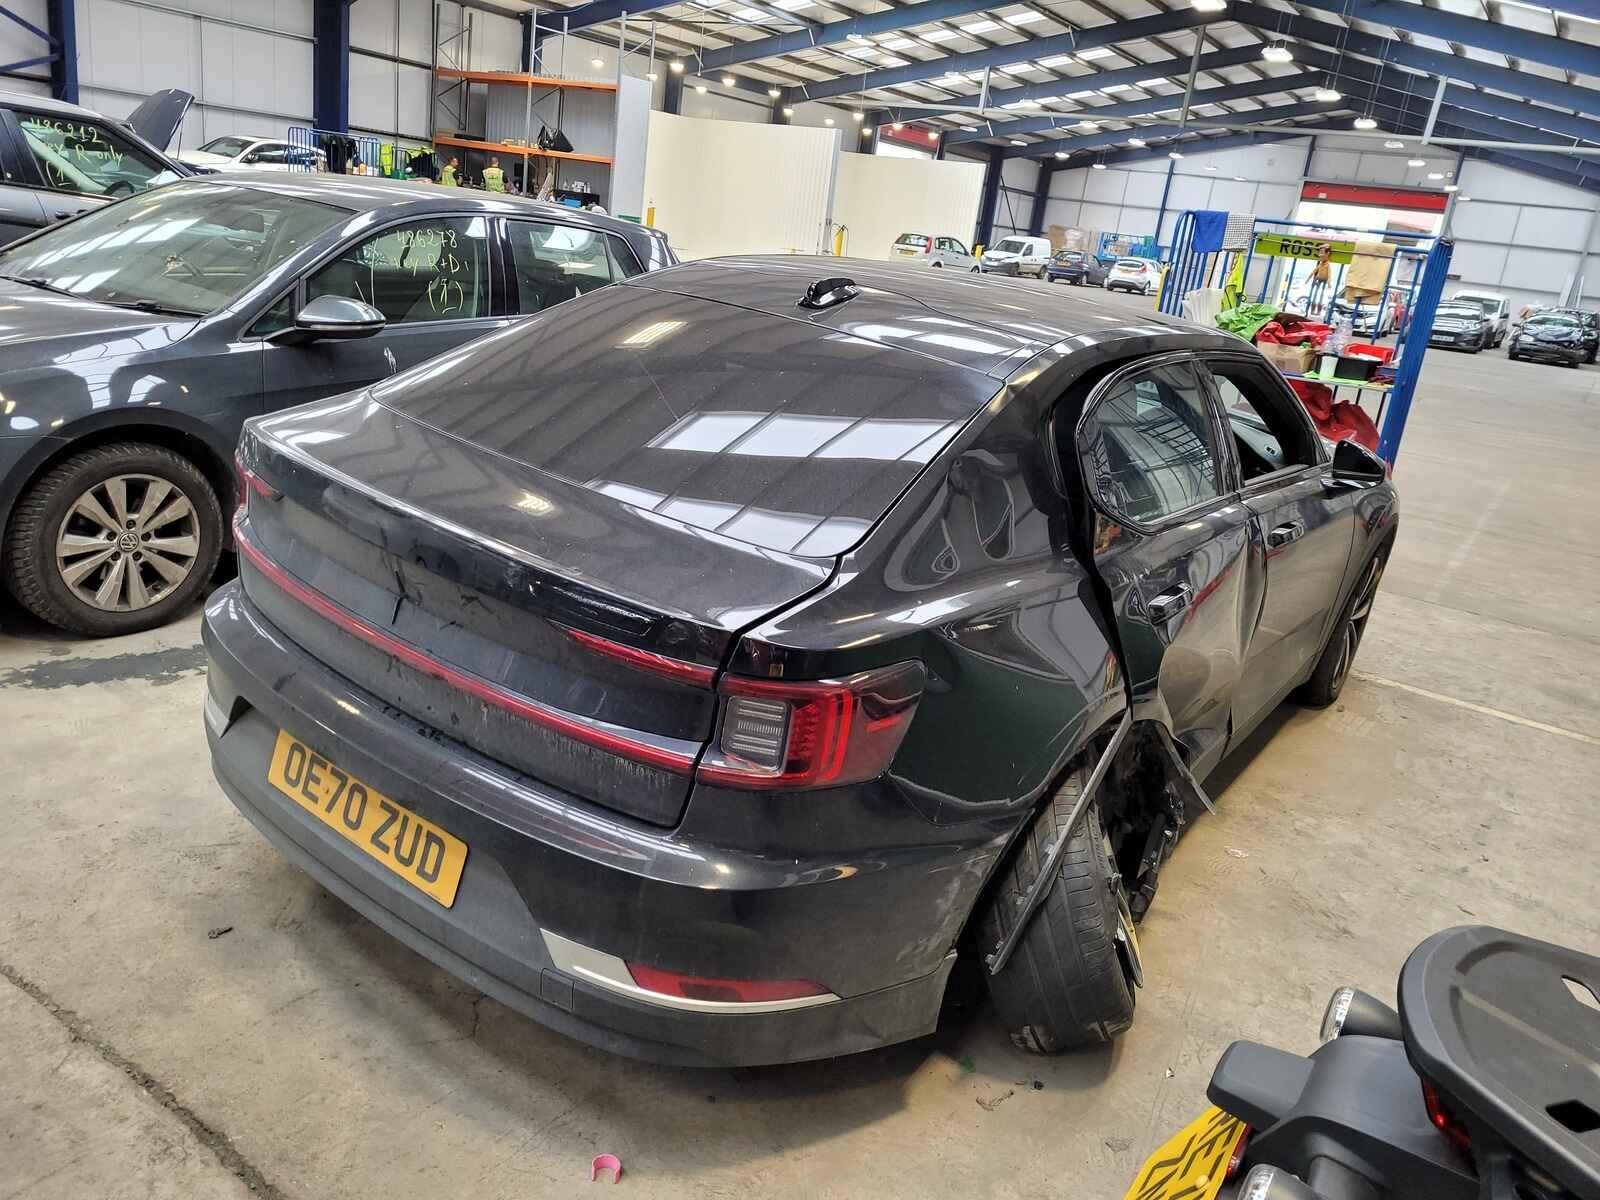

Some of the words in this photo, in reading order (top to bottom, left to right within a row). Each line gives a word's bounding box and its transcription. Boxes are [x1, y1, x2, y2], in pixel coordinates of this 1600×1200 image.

[396, 228, 458, 249] 486278
[283, 741, 368, 831] OE70
[370, 800, 446, 883] ZUD
